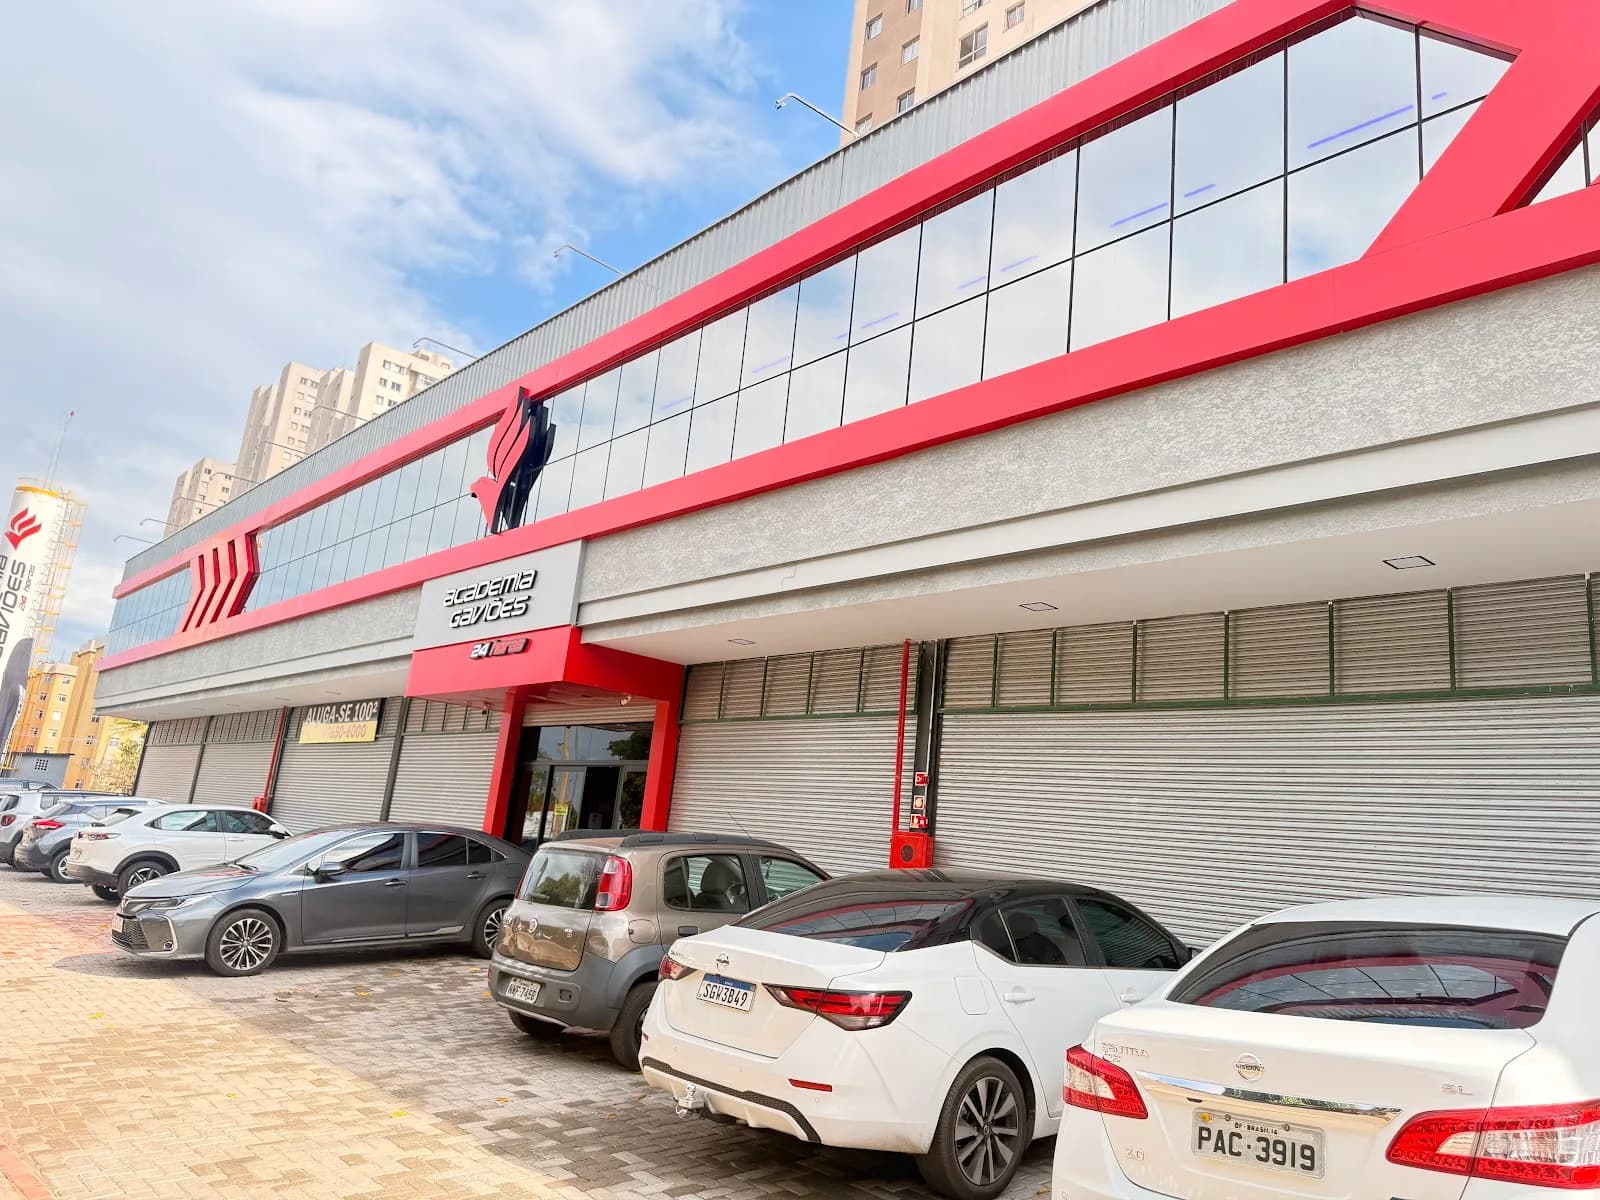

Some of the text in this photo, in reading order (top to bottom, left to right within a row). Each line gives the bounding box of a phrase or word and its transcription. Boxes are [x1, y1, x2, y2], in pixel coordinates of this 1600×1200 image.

[470, 642, 493, 660] 24
[305, 703, 354, 724] ALUGA-SE
[702, 982, 749, 1008] SGW3B49
